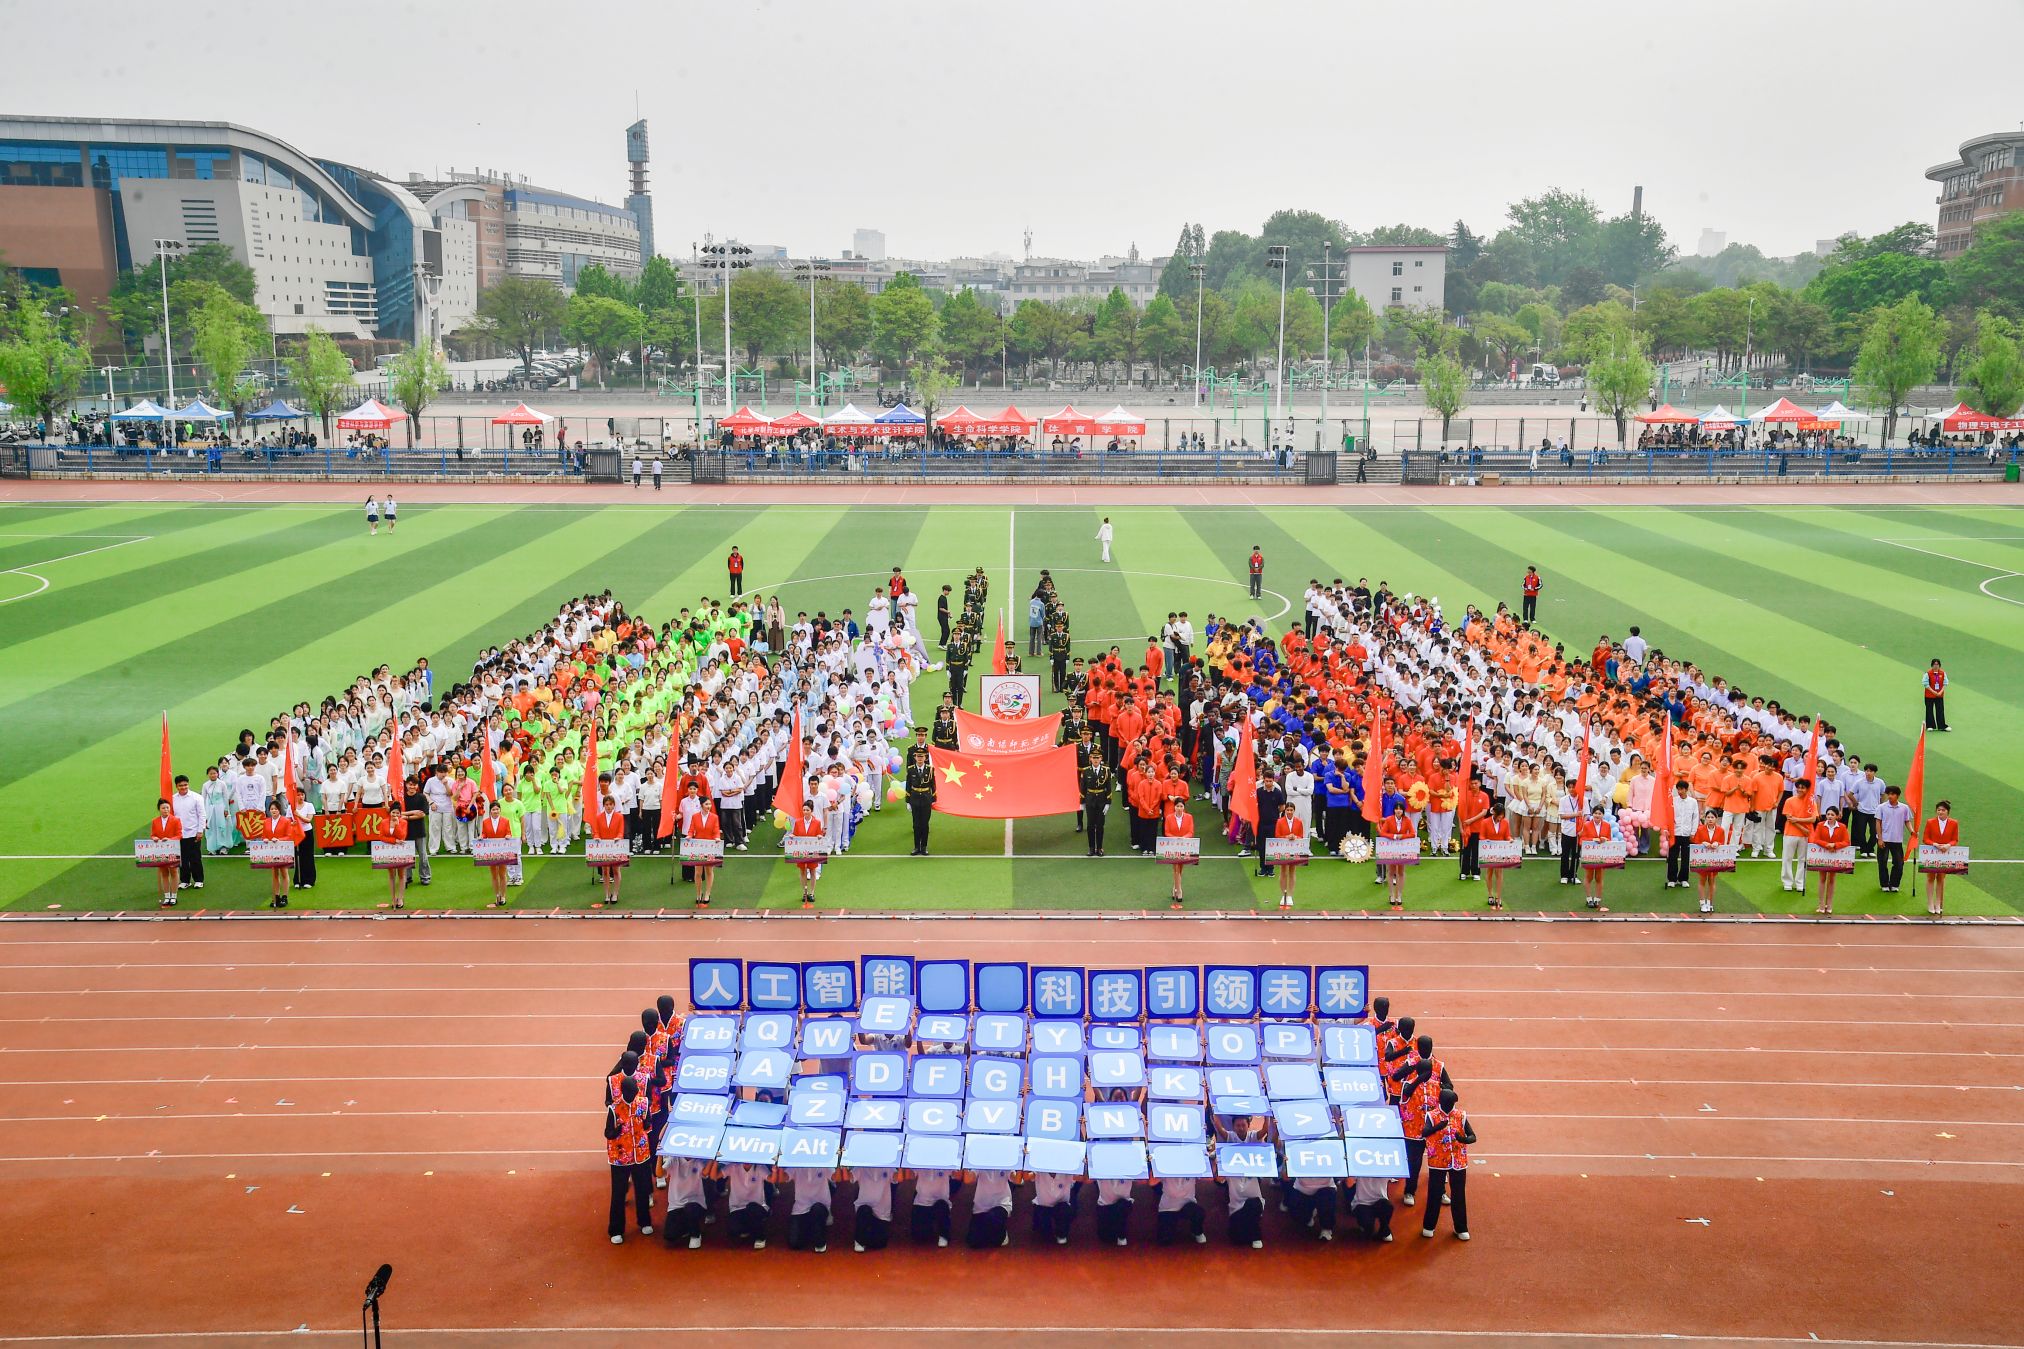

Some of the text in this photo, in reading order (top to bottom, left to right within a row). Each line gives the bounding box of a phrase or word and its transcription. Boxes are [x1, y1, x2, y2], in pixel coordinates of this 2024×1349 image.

[826, 426, 925, 435] 美术与艺术设计学院
[953, 425, 1022, 434] 生命科学学院
[1048, 425, 1139, 434] 体育学院
[1957, 421, 2024, 430] 物理与电子工
[239, 811, 265, 838] 修
[322, 817, 347, 843] 场
[361, 814, 383, 835] 化
[700, 964, 1360, 1013] 人工智能 科技引领未来
[690, 1027, 732, 1041] Tab
[758, 1020, 778, 1041] Q
[814, 1028, 843, 1047] W
[875, 1005, 895, 1023] E
[931, 1021, 951, 1035] R
[991, 1022, 1009, 1041] T
[1047, 1028, 1067, 1046] Y
[1106, 1032, 1125, 1044] U
[1171, 1033, 1177, 1050] I
[1222, 1033, 1243, 1053] O
[1279, 1032, 1297, 1047] P
[680, 1063, 728, 1080] Caps
[751, 1057, 774, 1077] A
[870, 1063, 889, 1084] D
[929, 1066, 946, 1086] F
[985, 1069, 1008, 1092] G
[1047, 1066, 1066, 1089] H
[1110, 1059, 1126, 1077] J
[1165, 1072, 1185, 1091] K
[1225, 1076, 1245, 1094] L
[1331, 1079, 1376, 1092] Enter
[679, 1100, 723, 1115] Shift
[806, 1099, 826, 1117] Z
[864, 1106, 886, 1121] X
[923, 1108, 944, 1125] C
[983, 1107, 1004, 1123] V
[1041, 1109, 1062, 1131] B
[1104, 1111, 1125, 1128] N
[1165, 1114, 1189, 1132] M
[669, 1132, 1400, 1168] Ctrl Win Alt Alt Fn Ctrl
